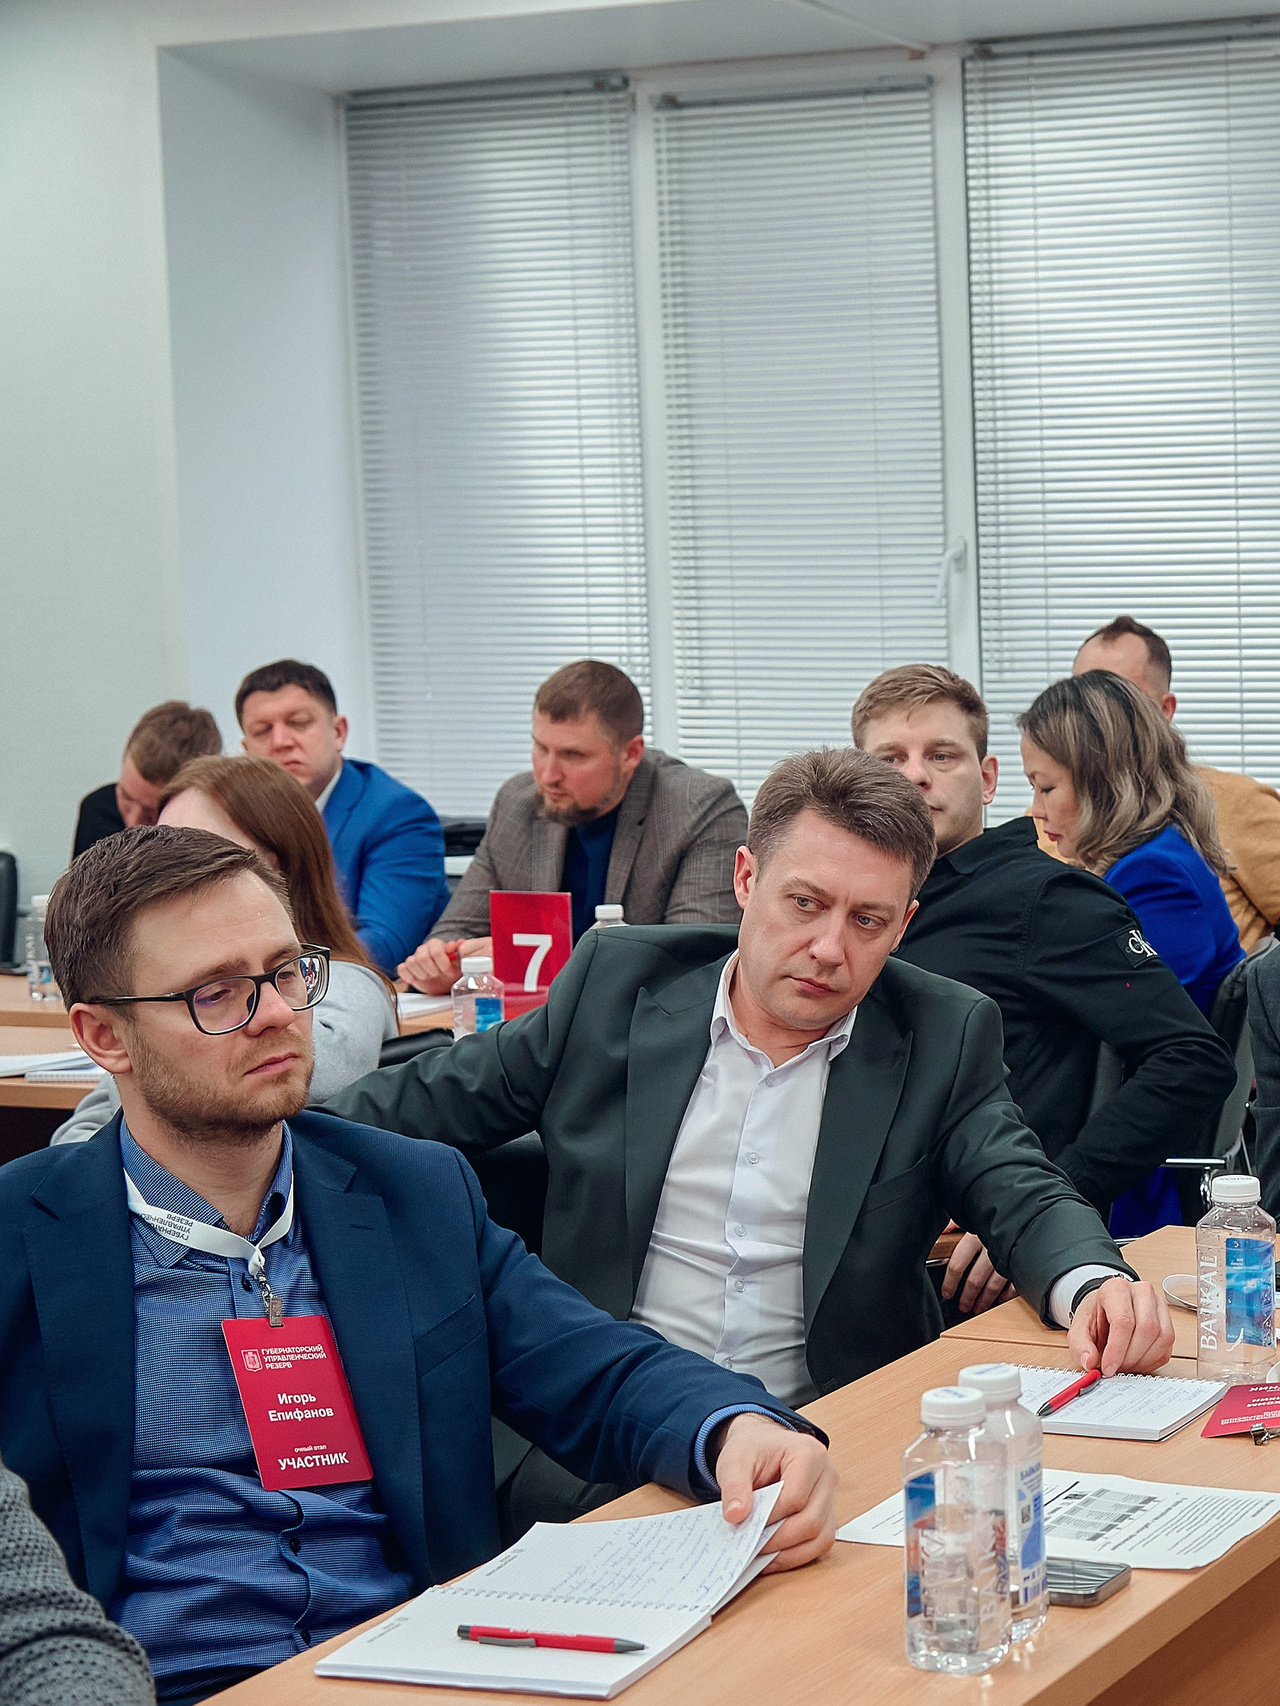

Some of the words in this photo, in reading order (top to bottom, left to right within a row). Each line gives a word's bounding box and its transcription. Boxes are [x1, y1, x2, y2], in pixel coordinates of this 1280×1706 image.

[512, 933, 553, 992] 7
[143, 1213, 191, 1234] УПРАВЛЕНЧЕС
[166, 1213, 193, 1227] РЕЗЕРВ
[1200, 1255, 1218, 1350] BAIKAL
[261, 1344, 324, 1354] ГУБЕРНАТОРСКИЙ
[263, 1352, 327, 1362] УПРАВЛЕНЧЕСКИЙ
[277, 1393, 317, 1405] Игорь
[268, 1407, 334, 1422] Епифанов
[278, 1452, 349, 1470] УЧАСТНИК
